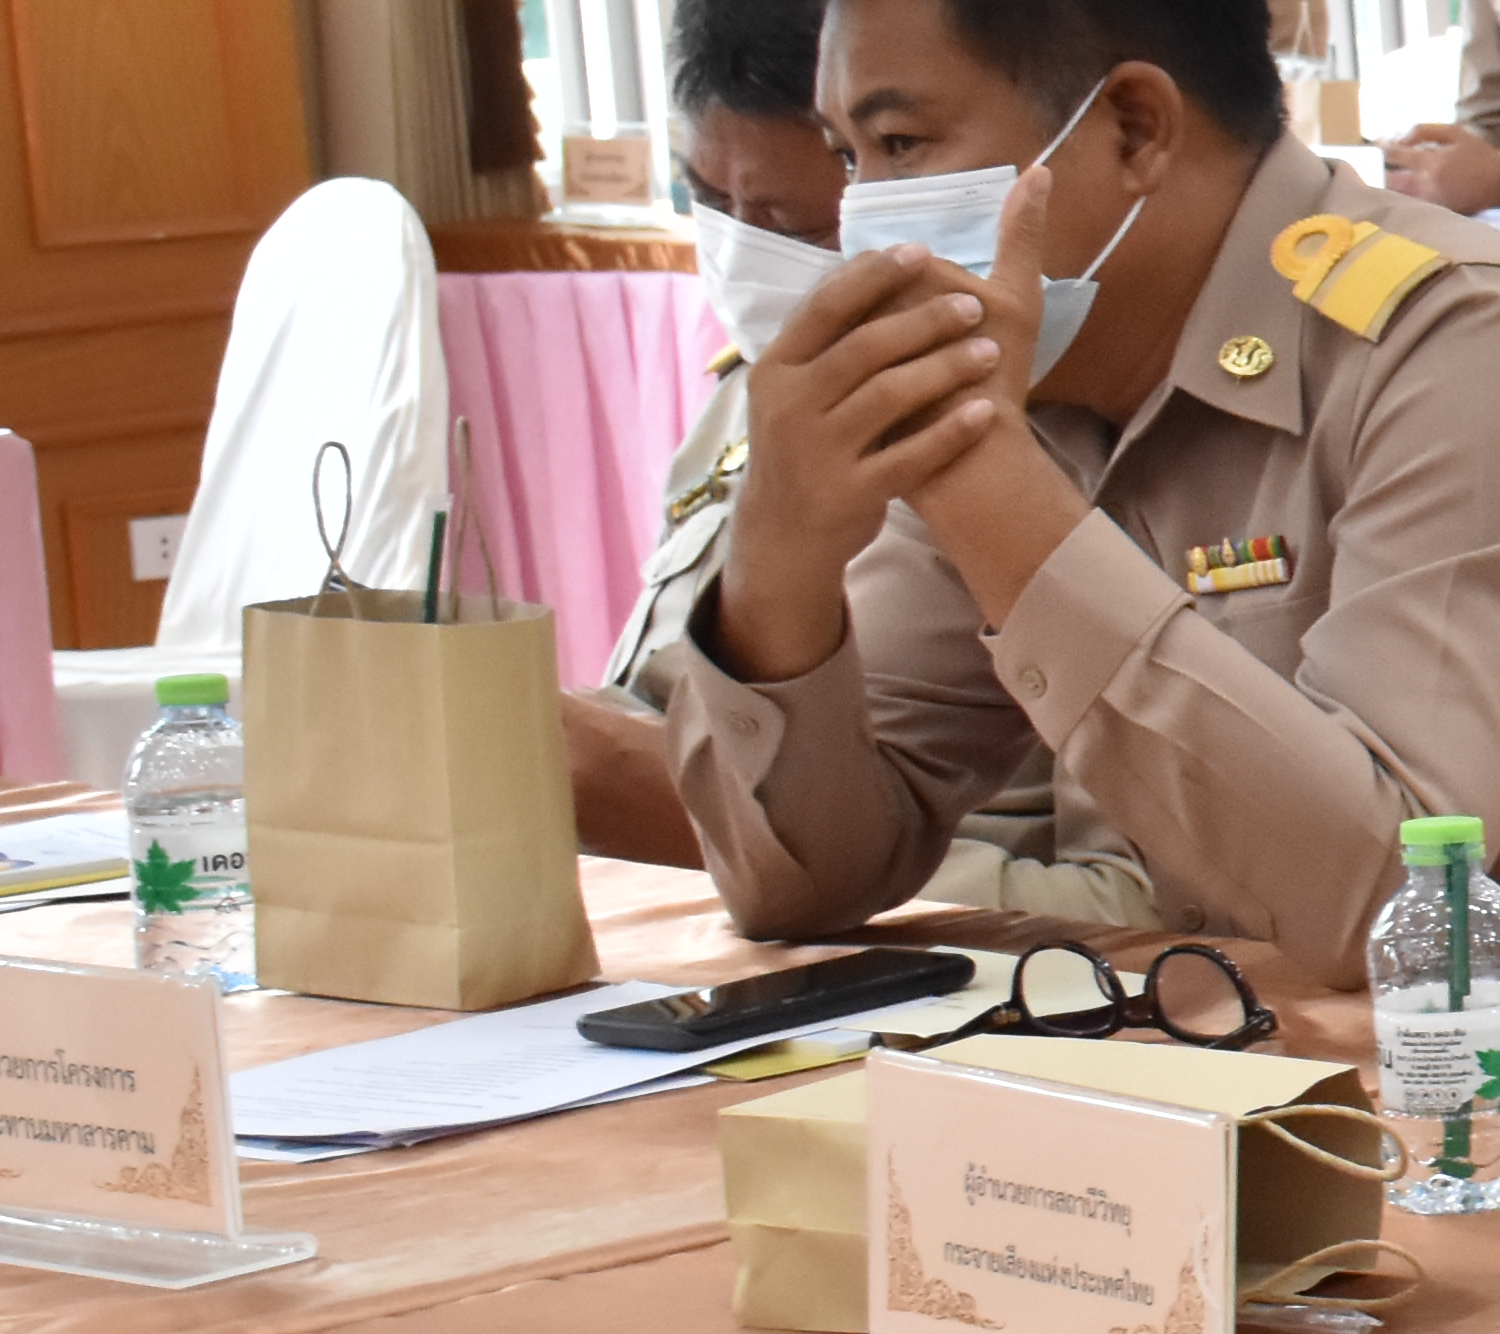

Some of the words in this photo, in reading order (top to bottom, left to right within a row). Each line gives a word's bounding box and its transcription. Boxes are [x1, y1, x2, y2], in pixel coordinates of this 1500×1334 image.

[202, 851, 245, 873] เดอ
[964, 1161, 1132, 1238] ผู้อำนวยการสถานีวิทยุ
[944, 1241, 1155, 1306] กระจายเสียงแห่งประเทศไทย
